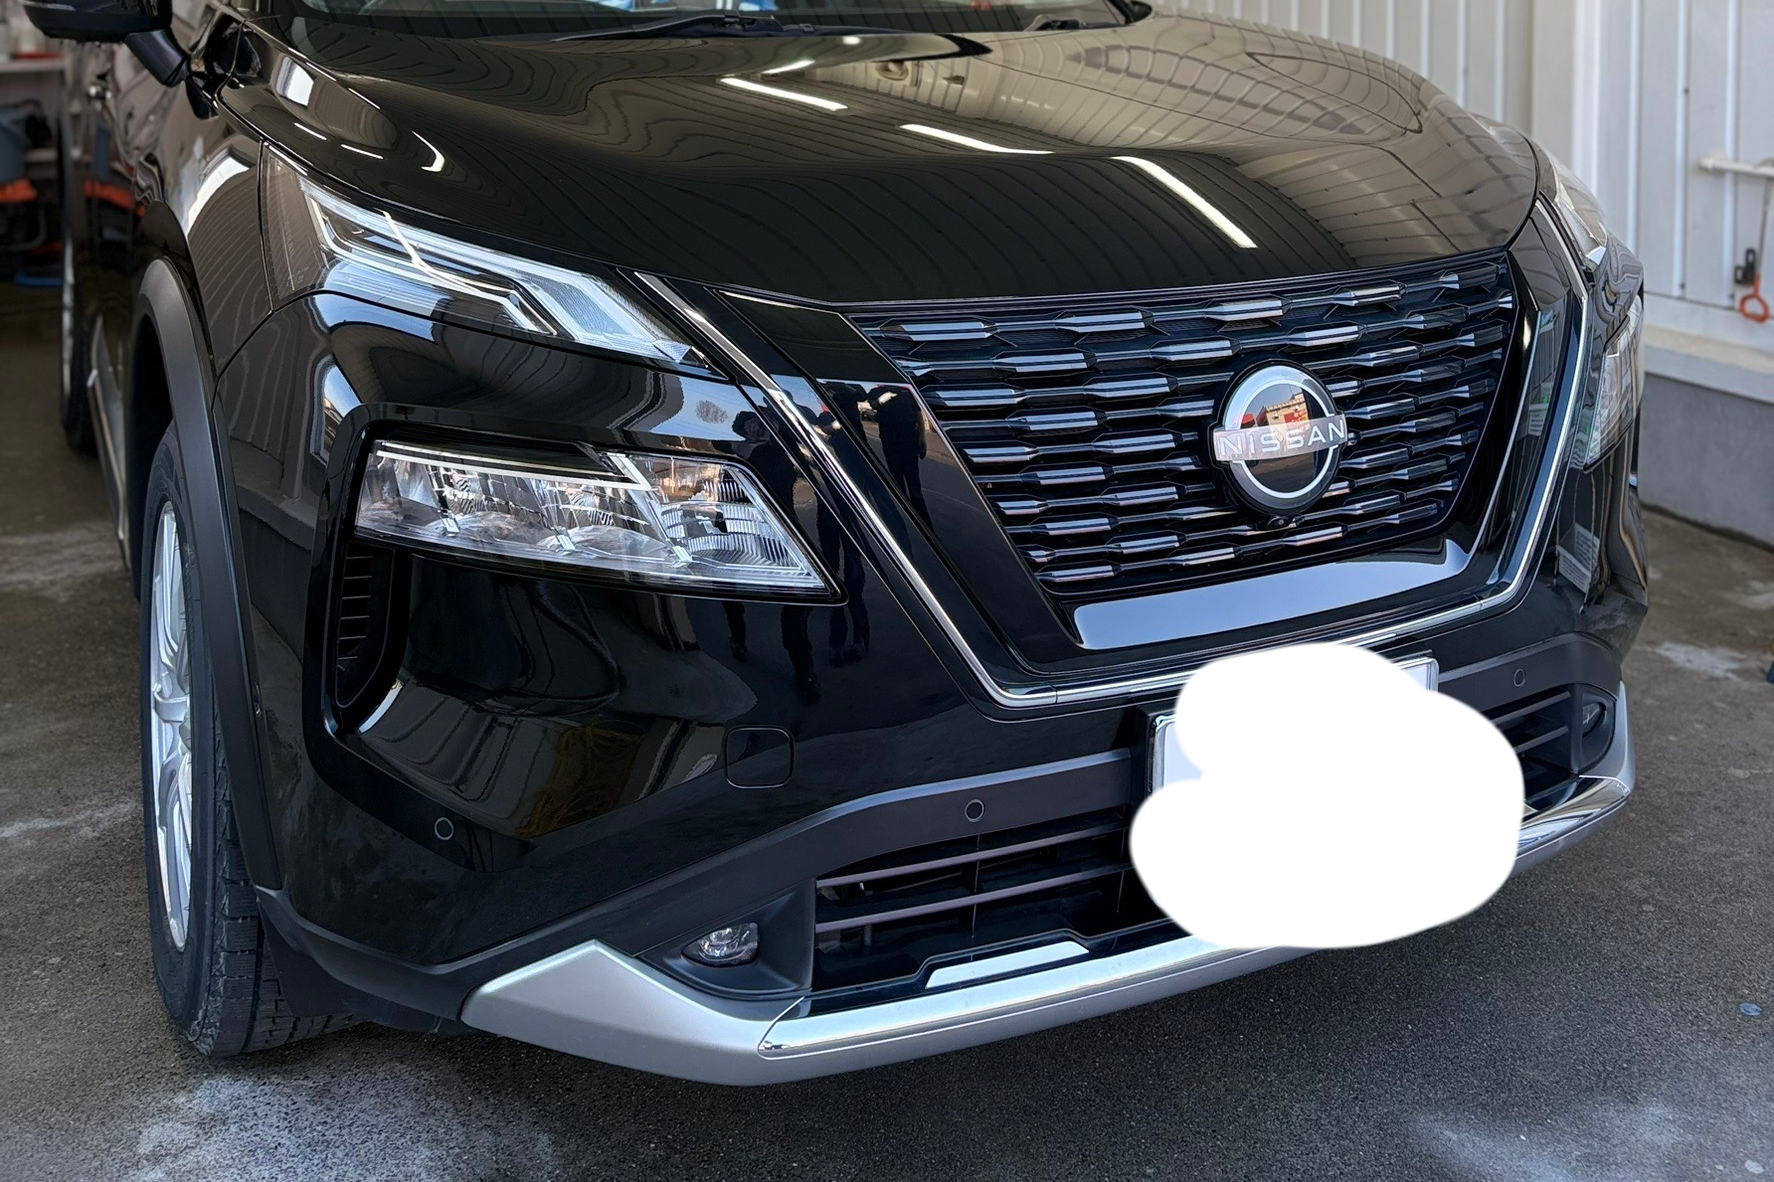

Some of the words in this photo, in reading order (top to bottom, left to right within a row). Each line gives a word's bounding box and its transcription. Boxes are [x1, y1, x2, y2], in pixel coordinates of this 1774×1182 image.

[1218, 419, 1345, 456] NISSAN
[1227, 687, 1375, 763] 旭川330
[1172, 809, 1208, 855] せ
[1221, 734, 1417, 866] 79-39
